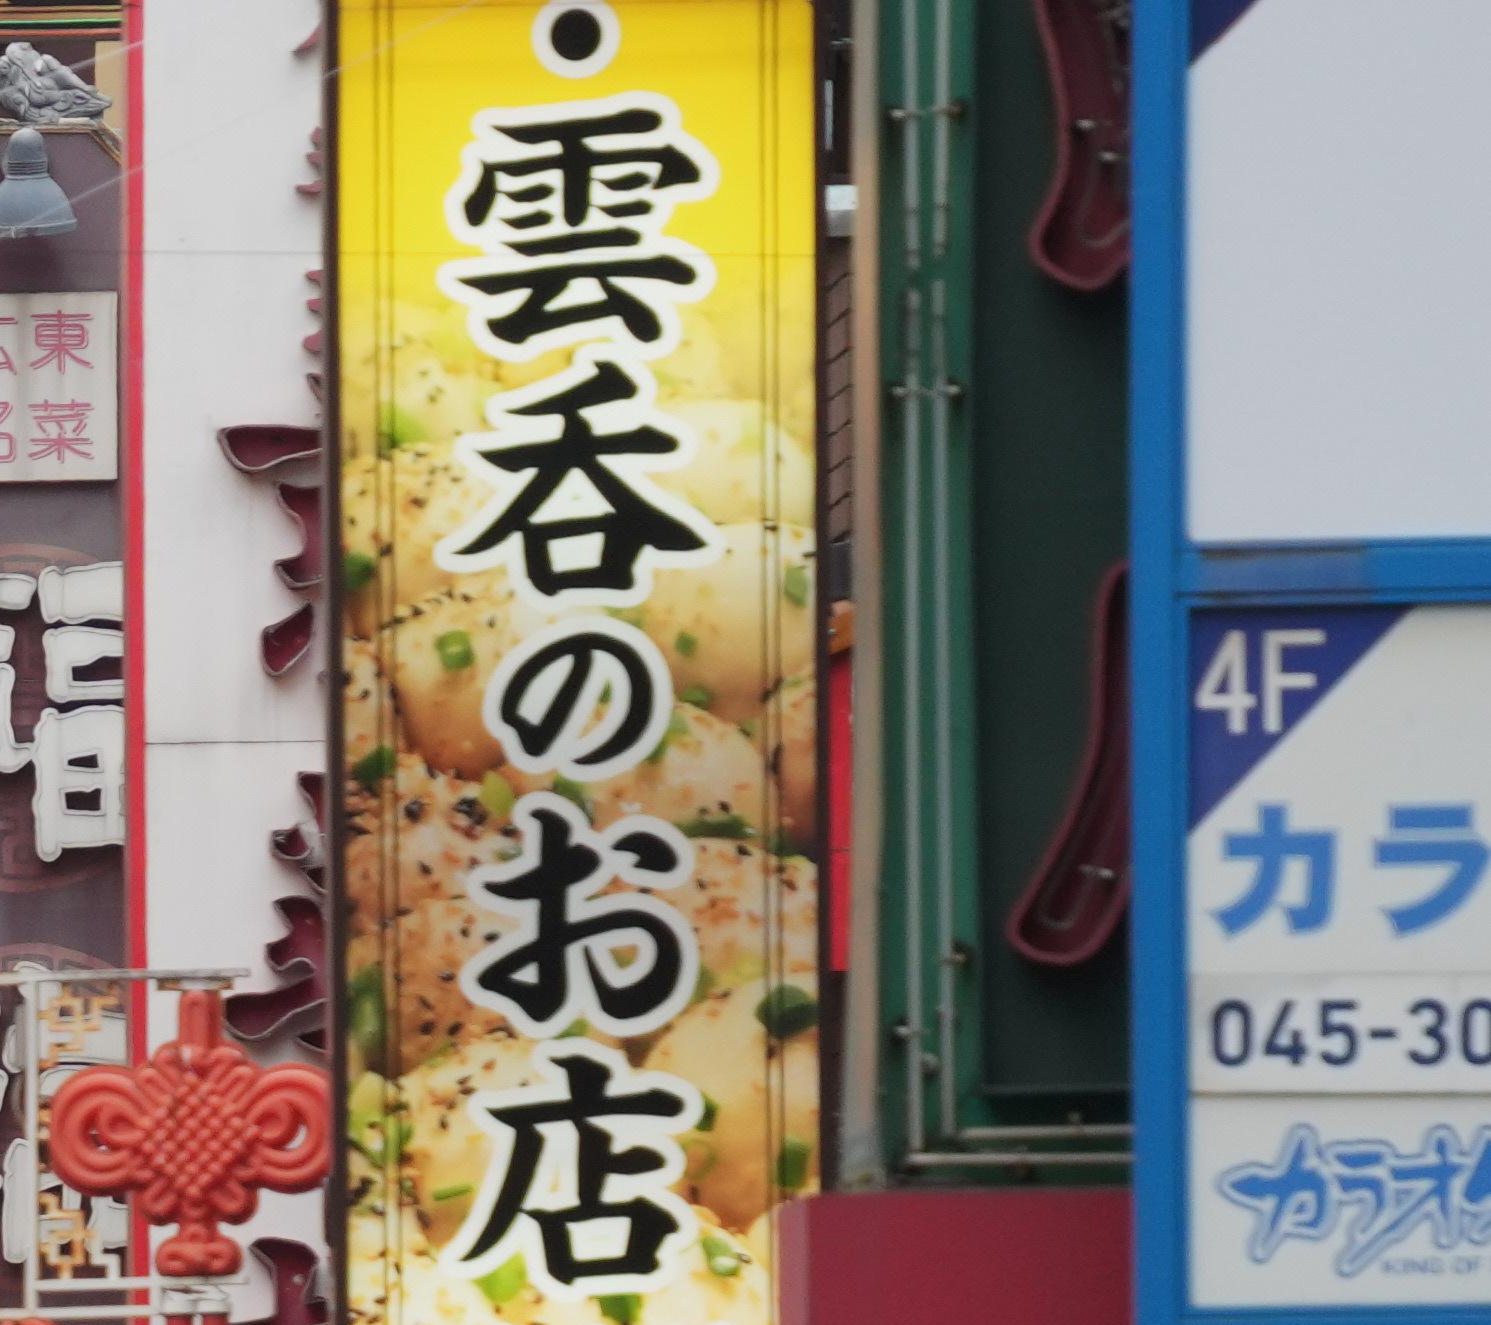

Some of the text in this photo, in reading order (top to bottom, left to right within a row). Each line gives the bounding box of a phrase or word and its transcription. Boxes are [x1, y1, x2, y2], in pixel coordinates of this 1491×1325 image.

[452, 107, 708, 1286] 雲呑のお店
[1196, 630, 1326, 734] 4F
